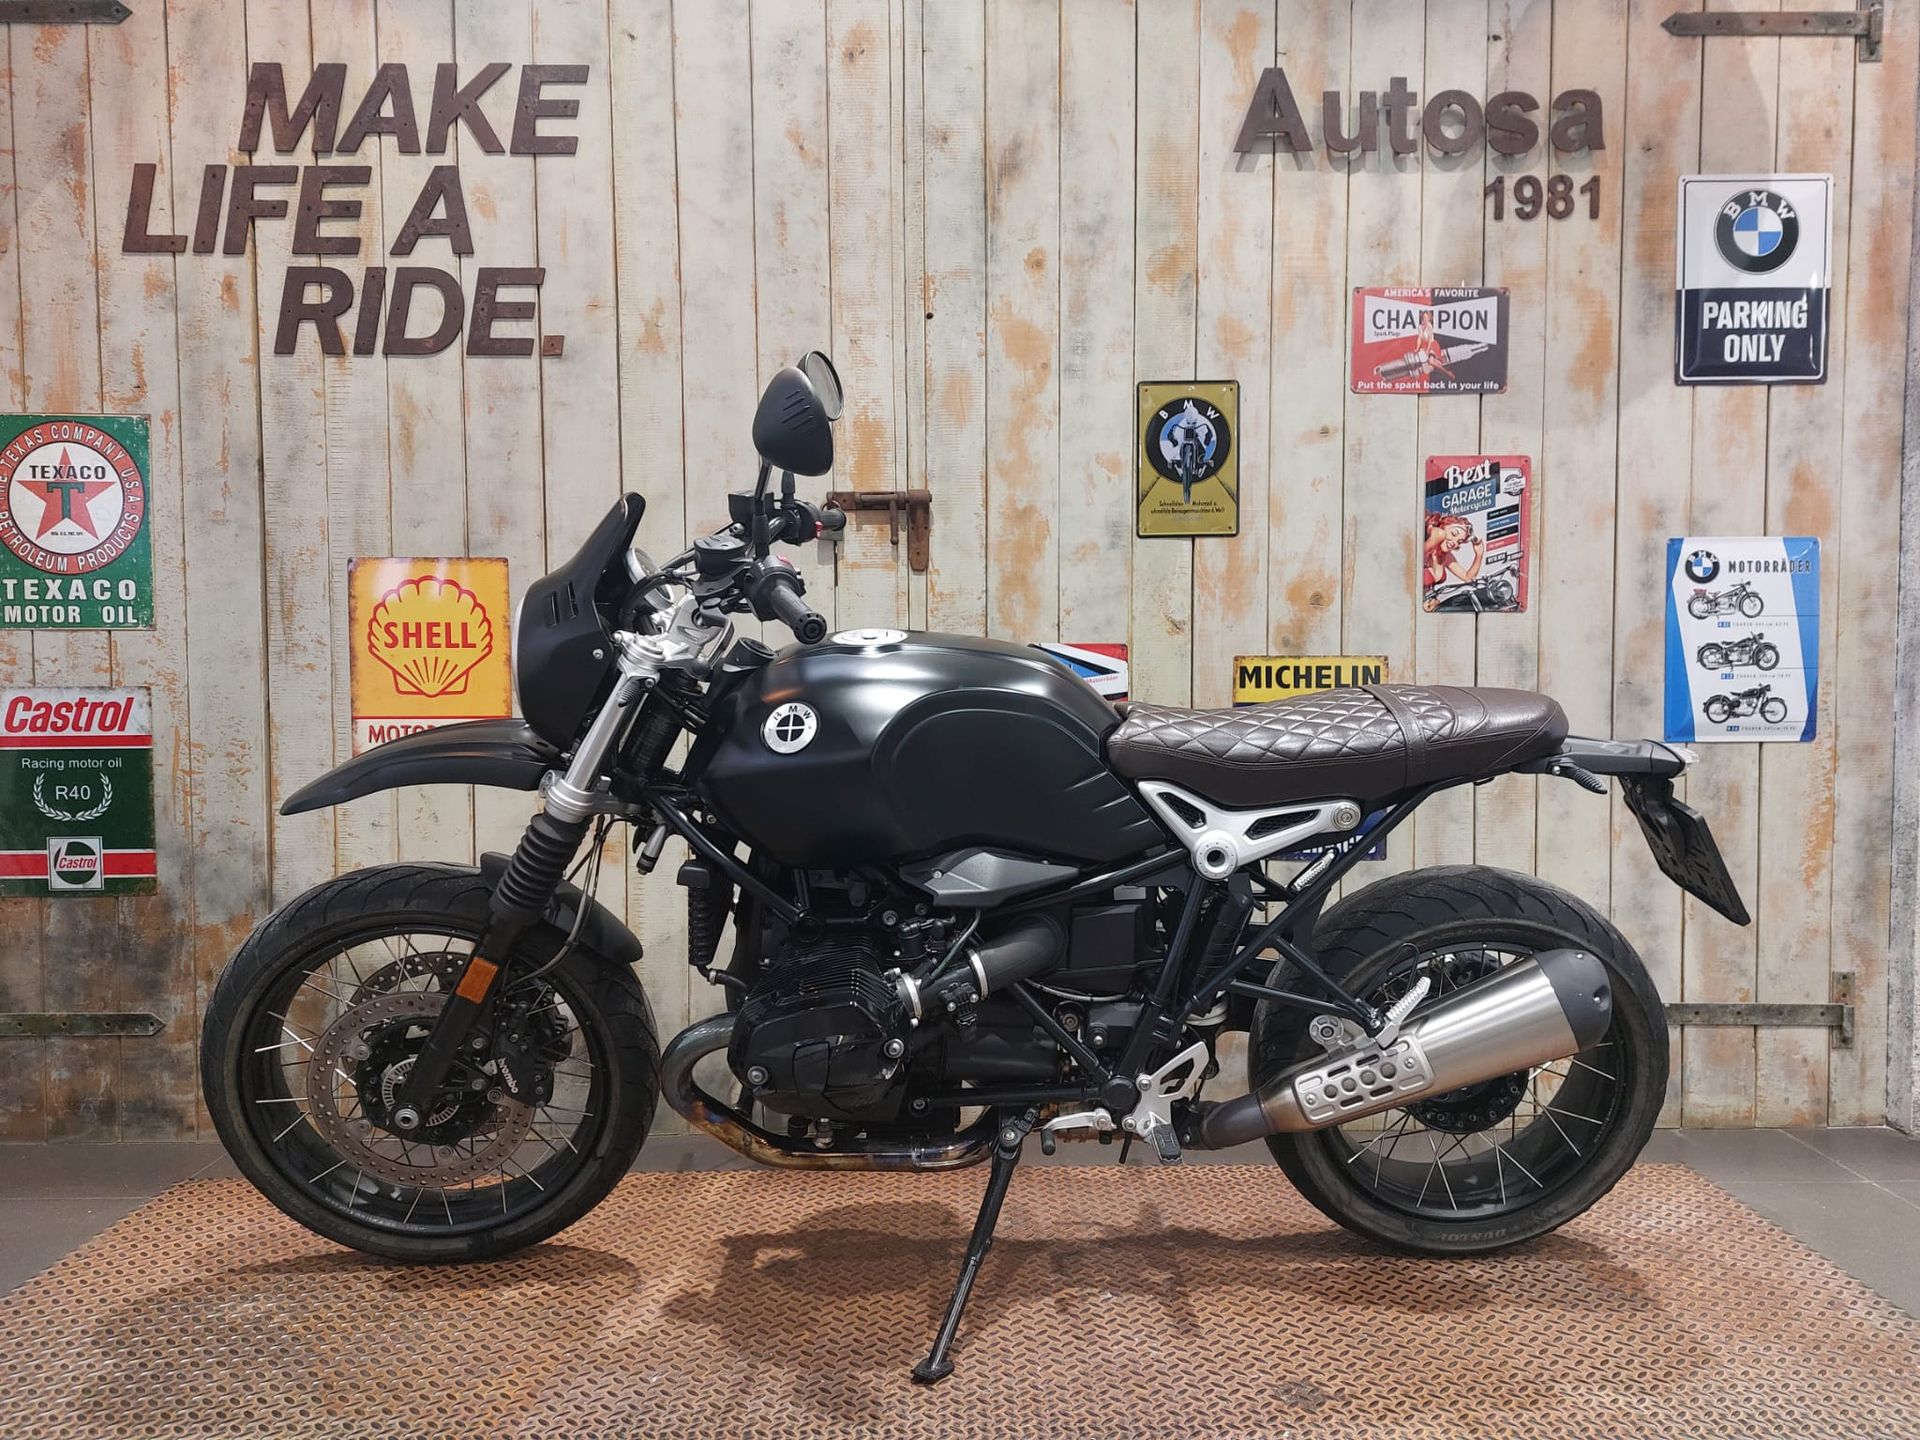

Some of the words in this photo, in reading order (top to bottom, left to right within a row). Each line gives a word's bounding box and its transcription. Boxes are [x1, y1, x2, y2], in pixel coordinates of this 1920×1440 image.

[238, 62, 590, 155] MAKE
[1233, 67, 1606, 153] Autosa
[122, 163, 372, 255] LIFE
[390, 165, 474, 255] A
[1485, 174, 1601, 221] 1981
[1723, 191, 1795, 220] BMW
[1384, 288, 1431, 298] AMERICA'S
[1434, 288, 1480, 298] FAVORITE
[274, 266, 565, 356] RIDE.
[1702, 300, 1808, 329] PARKING
[1723, 334, 1786, 363] ONLY
[1358, 381, 1374, 389] Put
[1376, 380, 1393, 389] the
[1394, 381, 1421, 391] spark
[1423, 380, 1446, 389] back
[1448, 380, 1457, 389] in
[1459, 381, 1481, 391] your
[1483, 381, 1499, 389] life
[1159, 399, 1220, 420] BMW
[0, 429, 44, 468] TEXAS
[51, 424, 126, 463] COMPANY
[29, 464, 107, 480] TEXACO
[1443, 458, 1492, 490] Best
[1441, 483, 1493, 509] GARAGE
[1450, 499, 1492, 515] Motorcycles
[0, 510, 68, 572] PETROLEUM
[77, 512, 140, 571] PRODUCTS
[1728, 558, 1812, 574] MOTORRÄDER
[2, 578, 137, 601] TEXACO
[4, 605, 81, 624] MOTOR
[102, 605, 138, 623] OIL
[383, 621, 477, 649] SHELL
[1239, 664, 1382, 689] MICHELIN
[4, 695, 135, 733] Castrol
[773, 705, 812, 721] BMW
[368, 724, 436, 744] MOT
[21, 758, 64, 771] Racing
[68, 759, 105, 769] motor
[107, 757, 122, 768] oil
[55, 785, 91, 800] R40
[58, 856, 98, 870] Castrol
[496, 1057, 519, 1094] brembo
